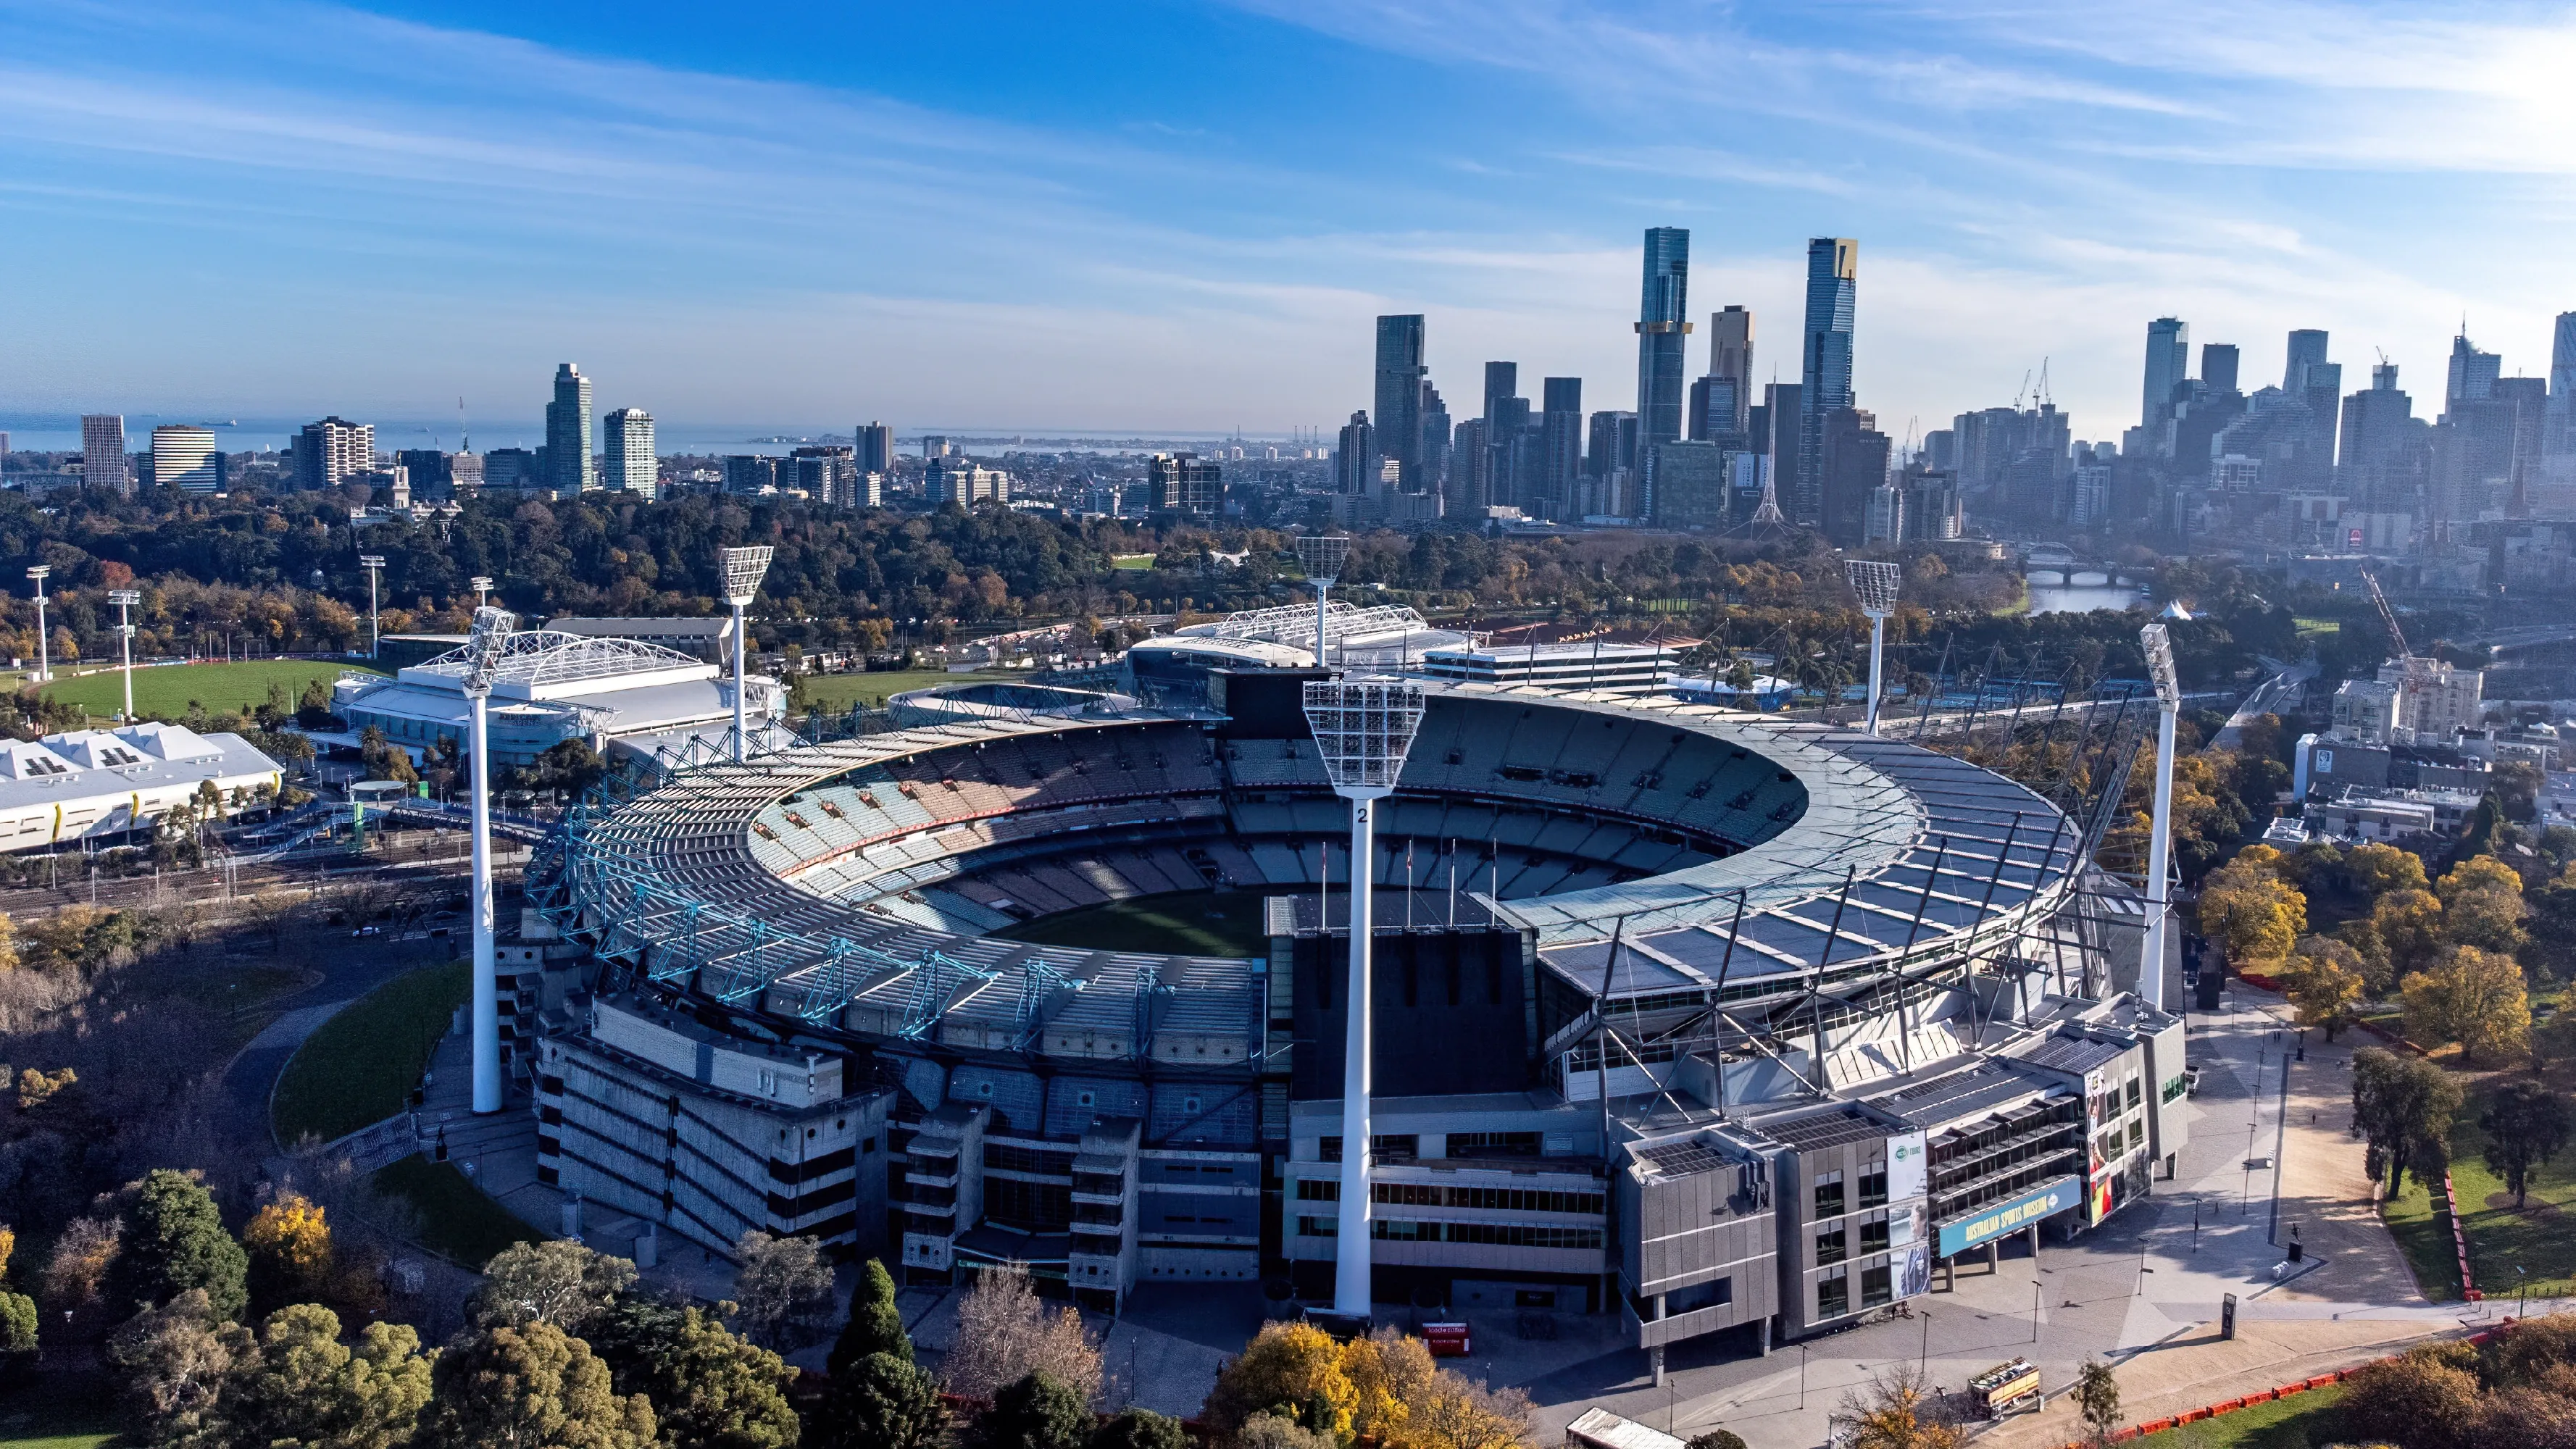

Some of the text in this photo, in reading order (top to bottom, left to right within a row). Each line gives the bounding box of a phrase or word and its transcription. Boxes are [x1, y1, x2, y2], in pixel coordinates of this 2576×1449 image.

[1357, 808, 1368, 823] 2
[1966, 1215, 1999, 1242] AUSTRALIAN
[2001, 1206, 2022, 1228] SPORTS
[2023, 1195, 2047, 1219] MUSEUM
